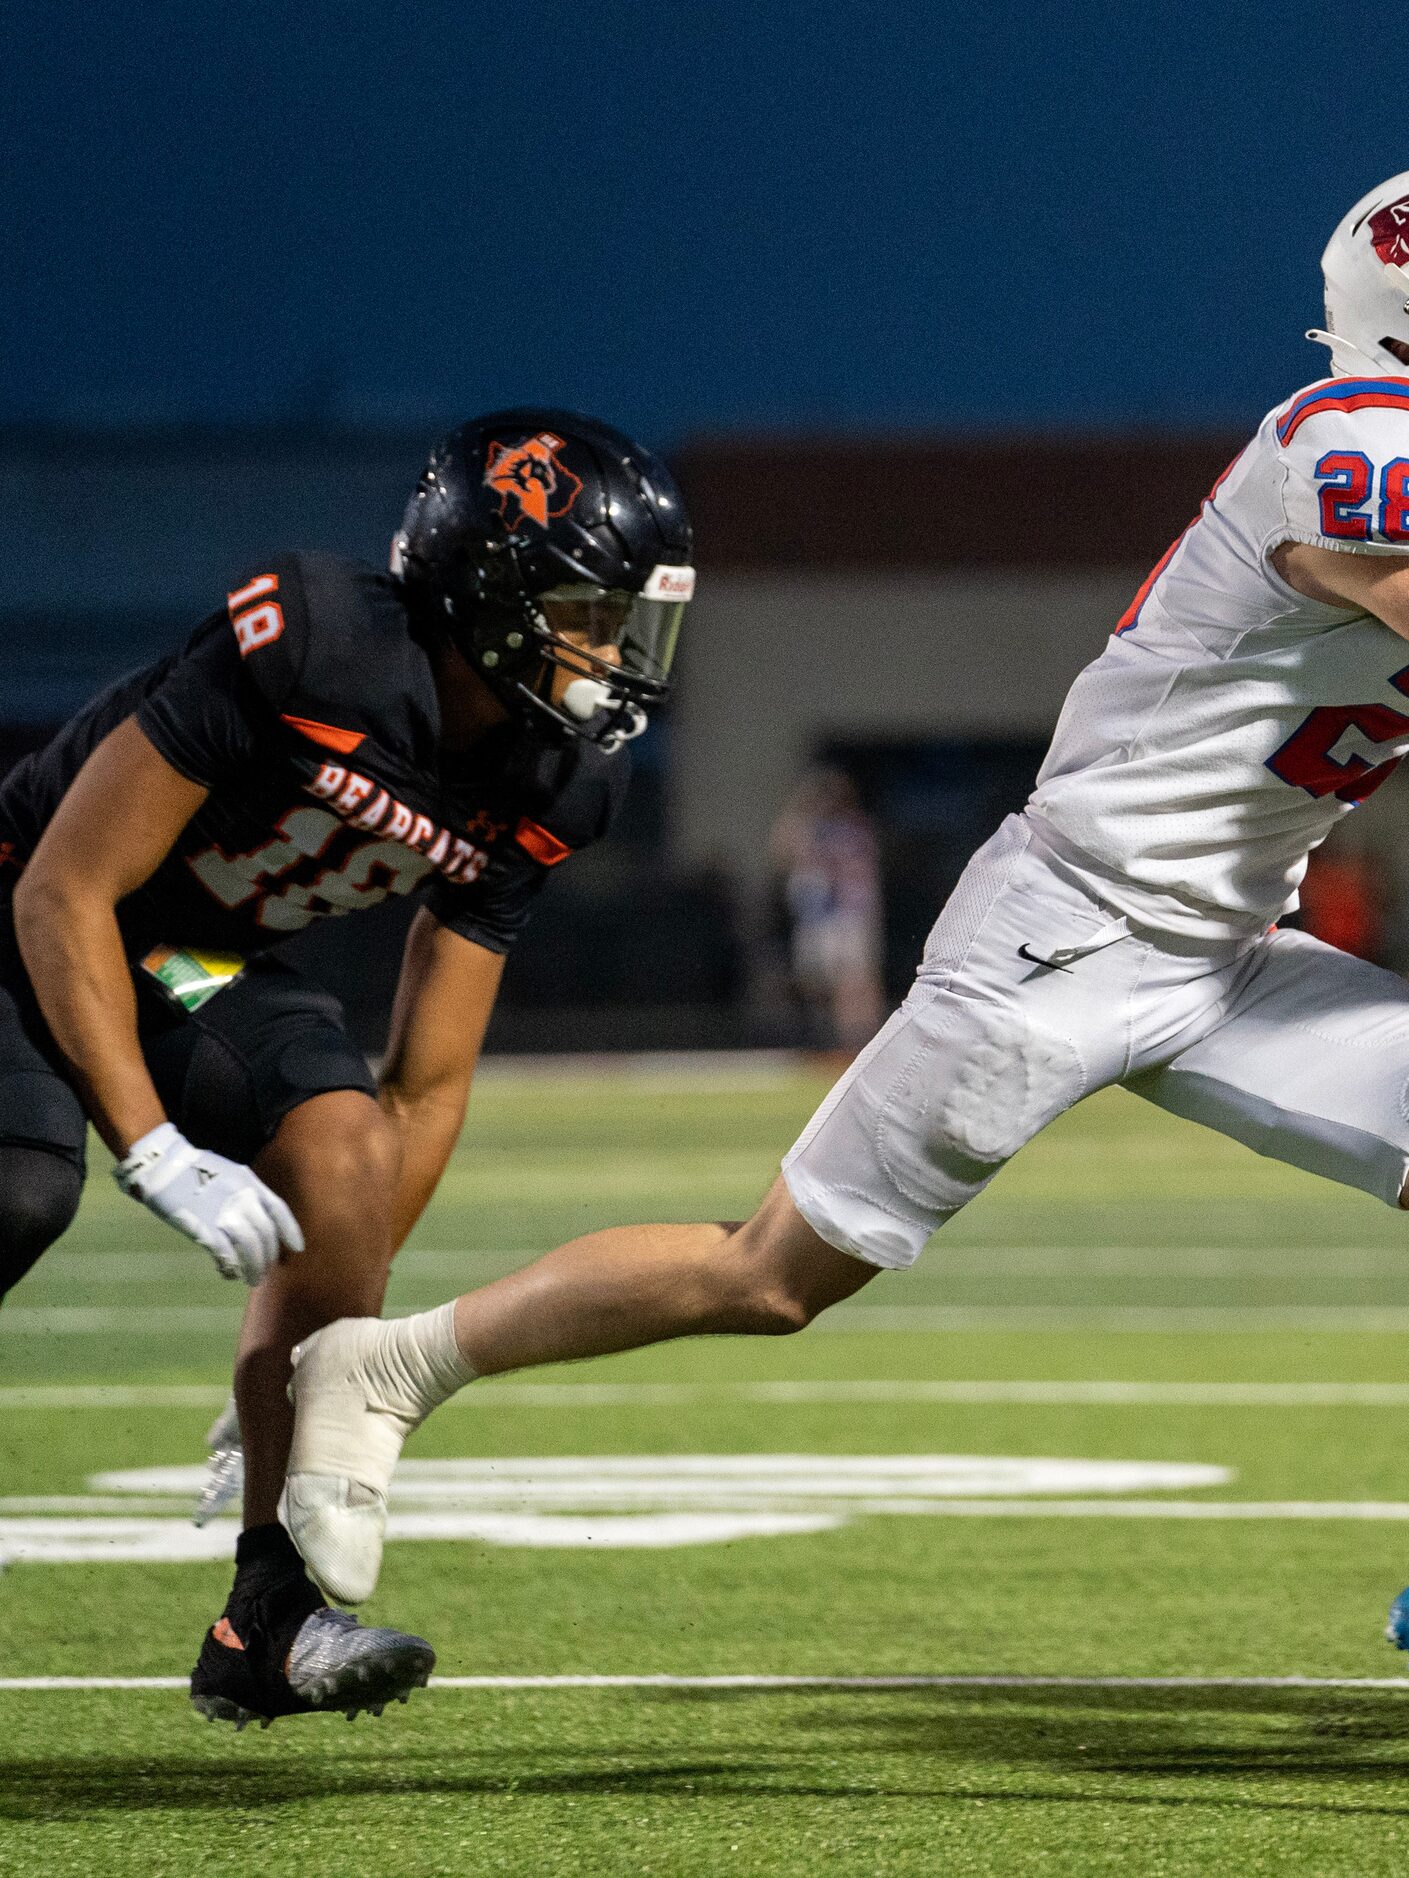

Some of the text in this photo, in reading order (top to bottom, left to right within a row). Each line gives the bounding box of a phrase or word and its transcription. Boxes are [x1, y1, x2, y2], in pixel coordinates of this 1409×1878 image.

[227, 573, 285, 657] 18
[185, 805, 437, 931] 18
[303, 758, 488, 885] BEARCATS
